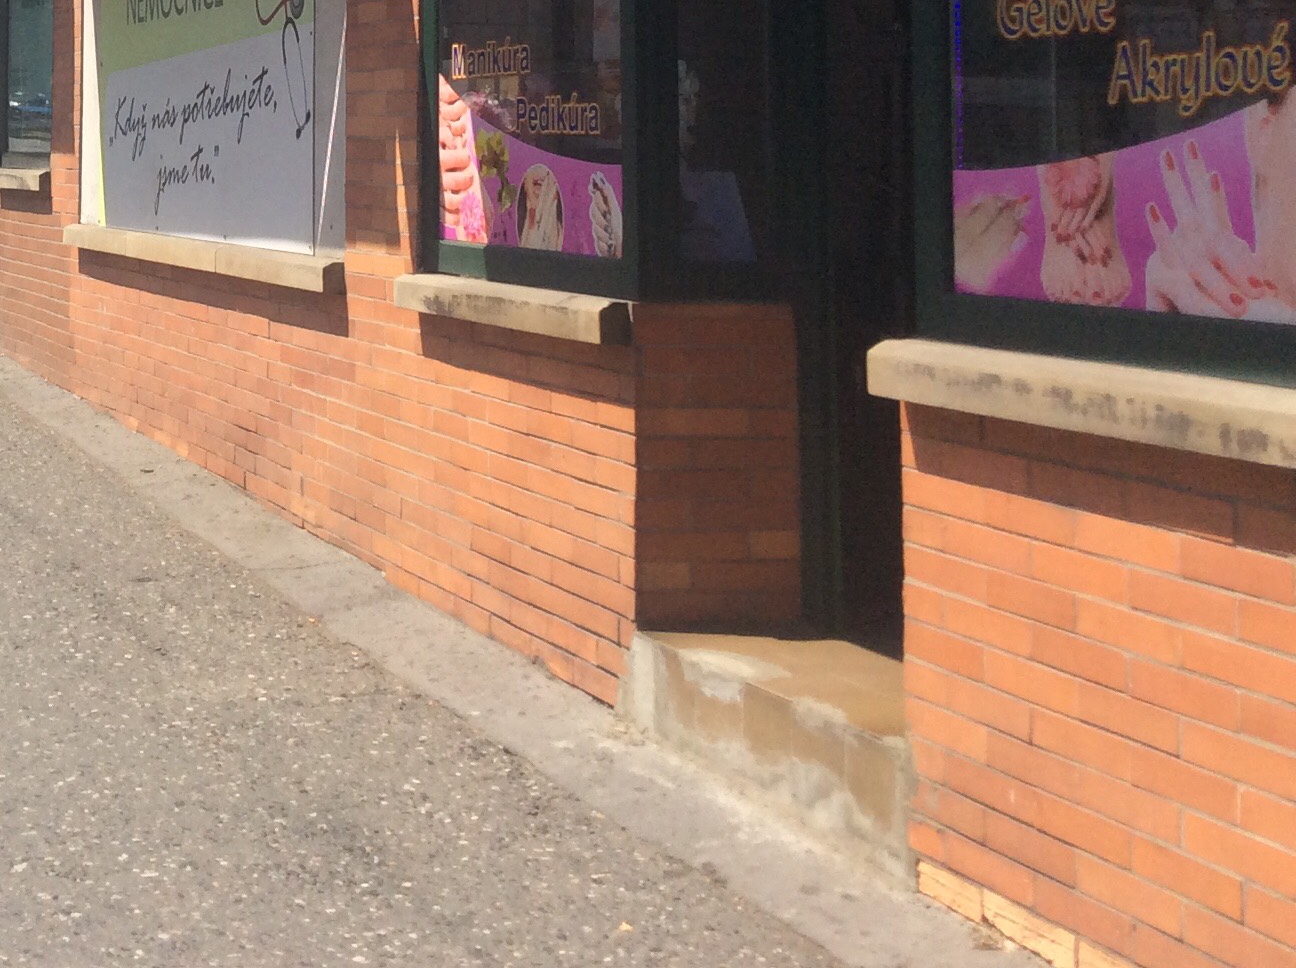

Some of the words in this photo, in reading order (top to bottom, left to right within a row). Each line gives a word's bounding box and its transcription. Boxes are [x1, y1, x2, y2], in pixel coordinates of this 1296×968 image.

[451, 35, 532, 80] Manikúra
[1107, 19, 1293, 117] Akrylové
[152, 98, 179, 130] nás
[179, 66, 278, 145] potřebujete,
[515, 92, 601, 136] Pedikúra
[154, 154, 190, 216] jsme
